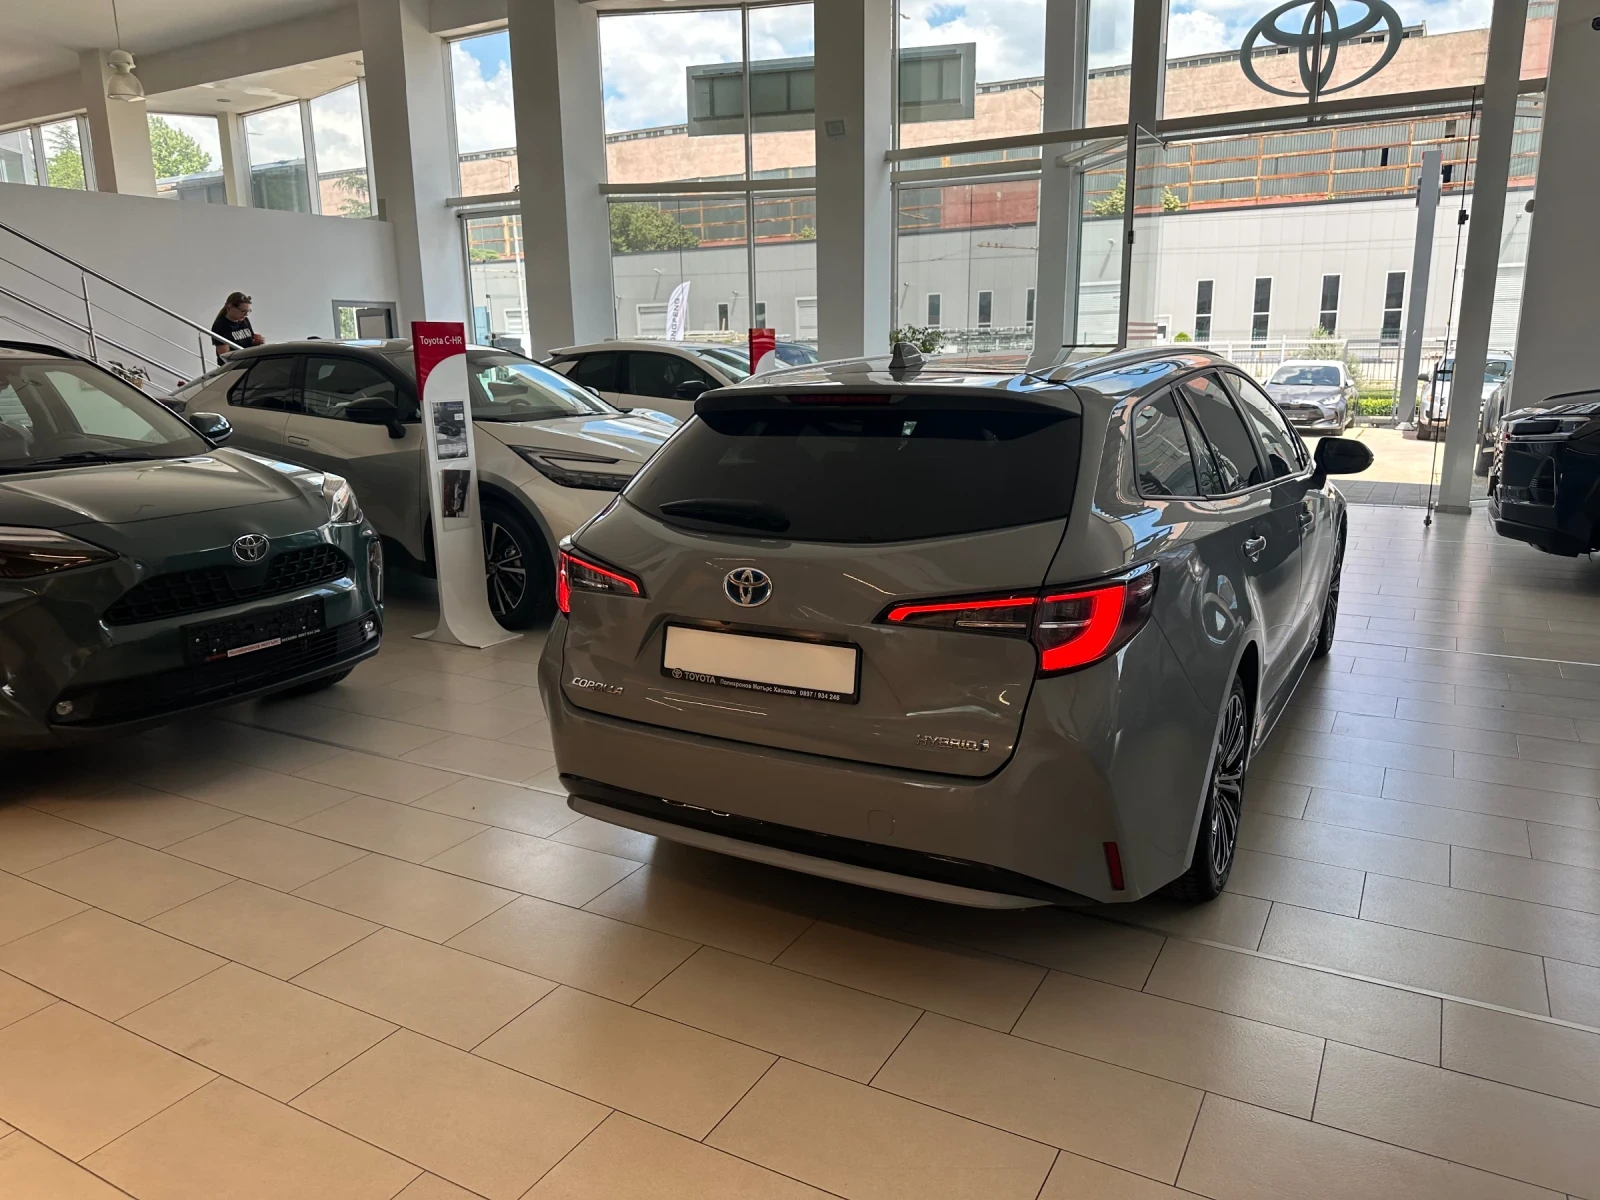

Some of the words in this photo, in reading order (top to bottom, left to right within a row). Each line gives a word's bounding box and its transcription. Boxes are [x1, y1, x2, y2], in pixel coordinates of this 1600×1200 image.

[419, 335, 444, 347] Toyota
[444, 335, 462, 345] C-HR
[572, 677, 623, 696] COROLLA
[684, 672, 716, 684] TOYOTA
[720, 678, 752, 689] Полихронов
[752, 683, 773, 693] Мотърс
[773, 686, 797, 696] Хасково
[817, 692, 828, 700] 934
[829, 693, 841, 702] 246
[916, 734, 979, 751] HYBRID
